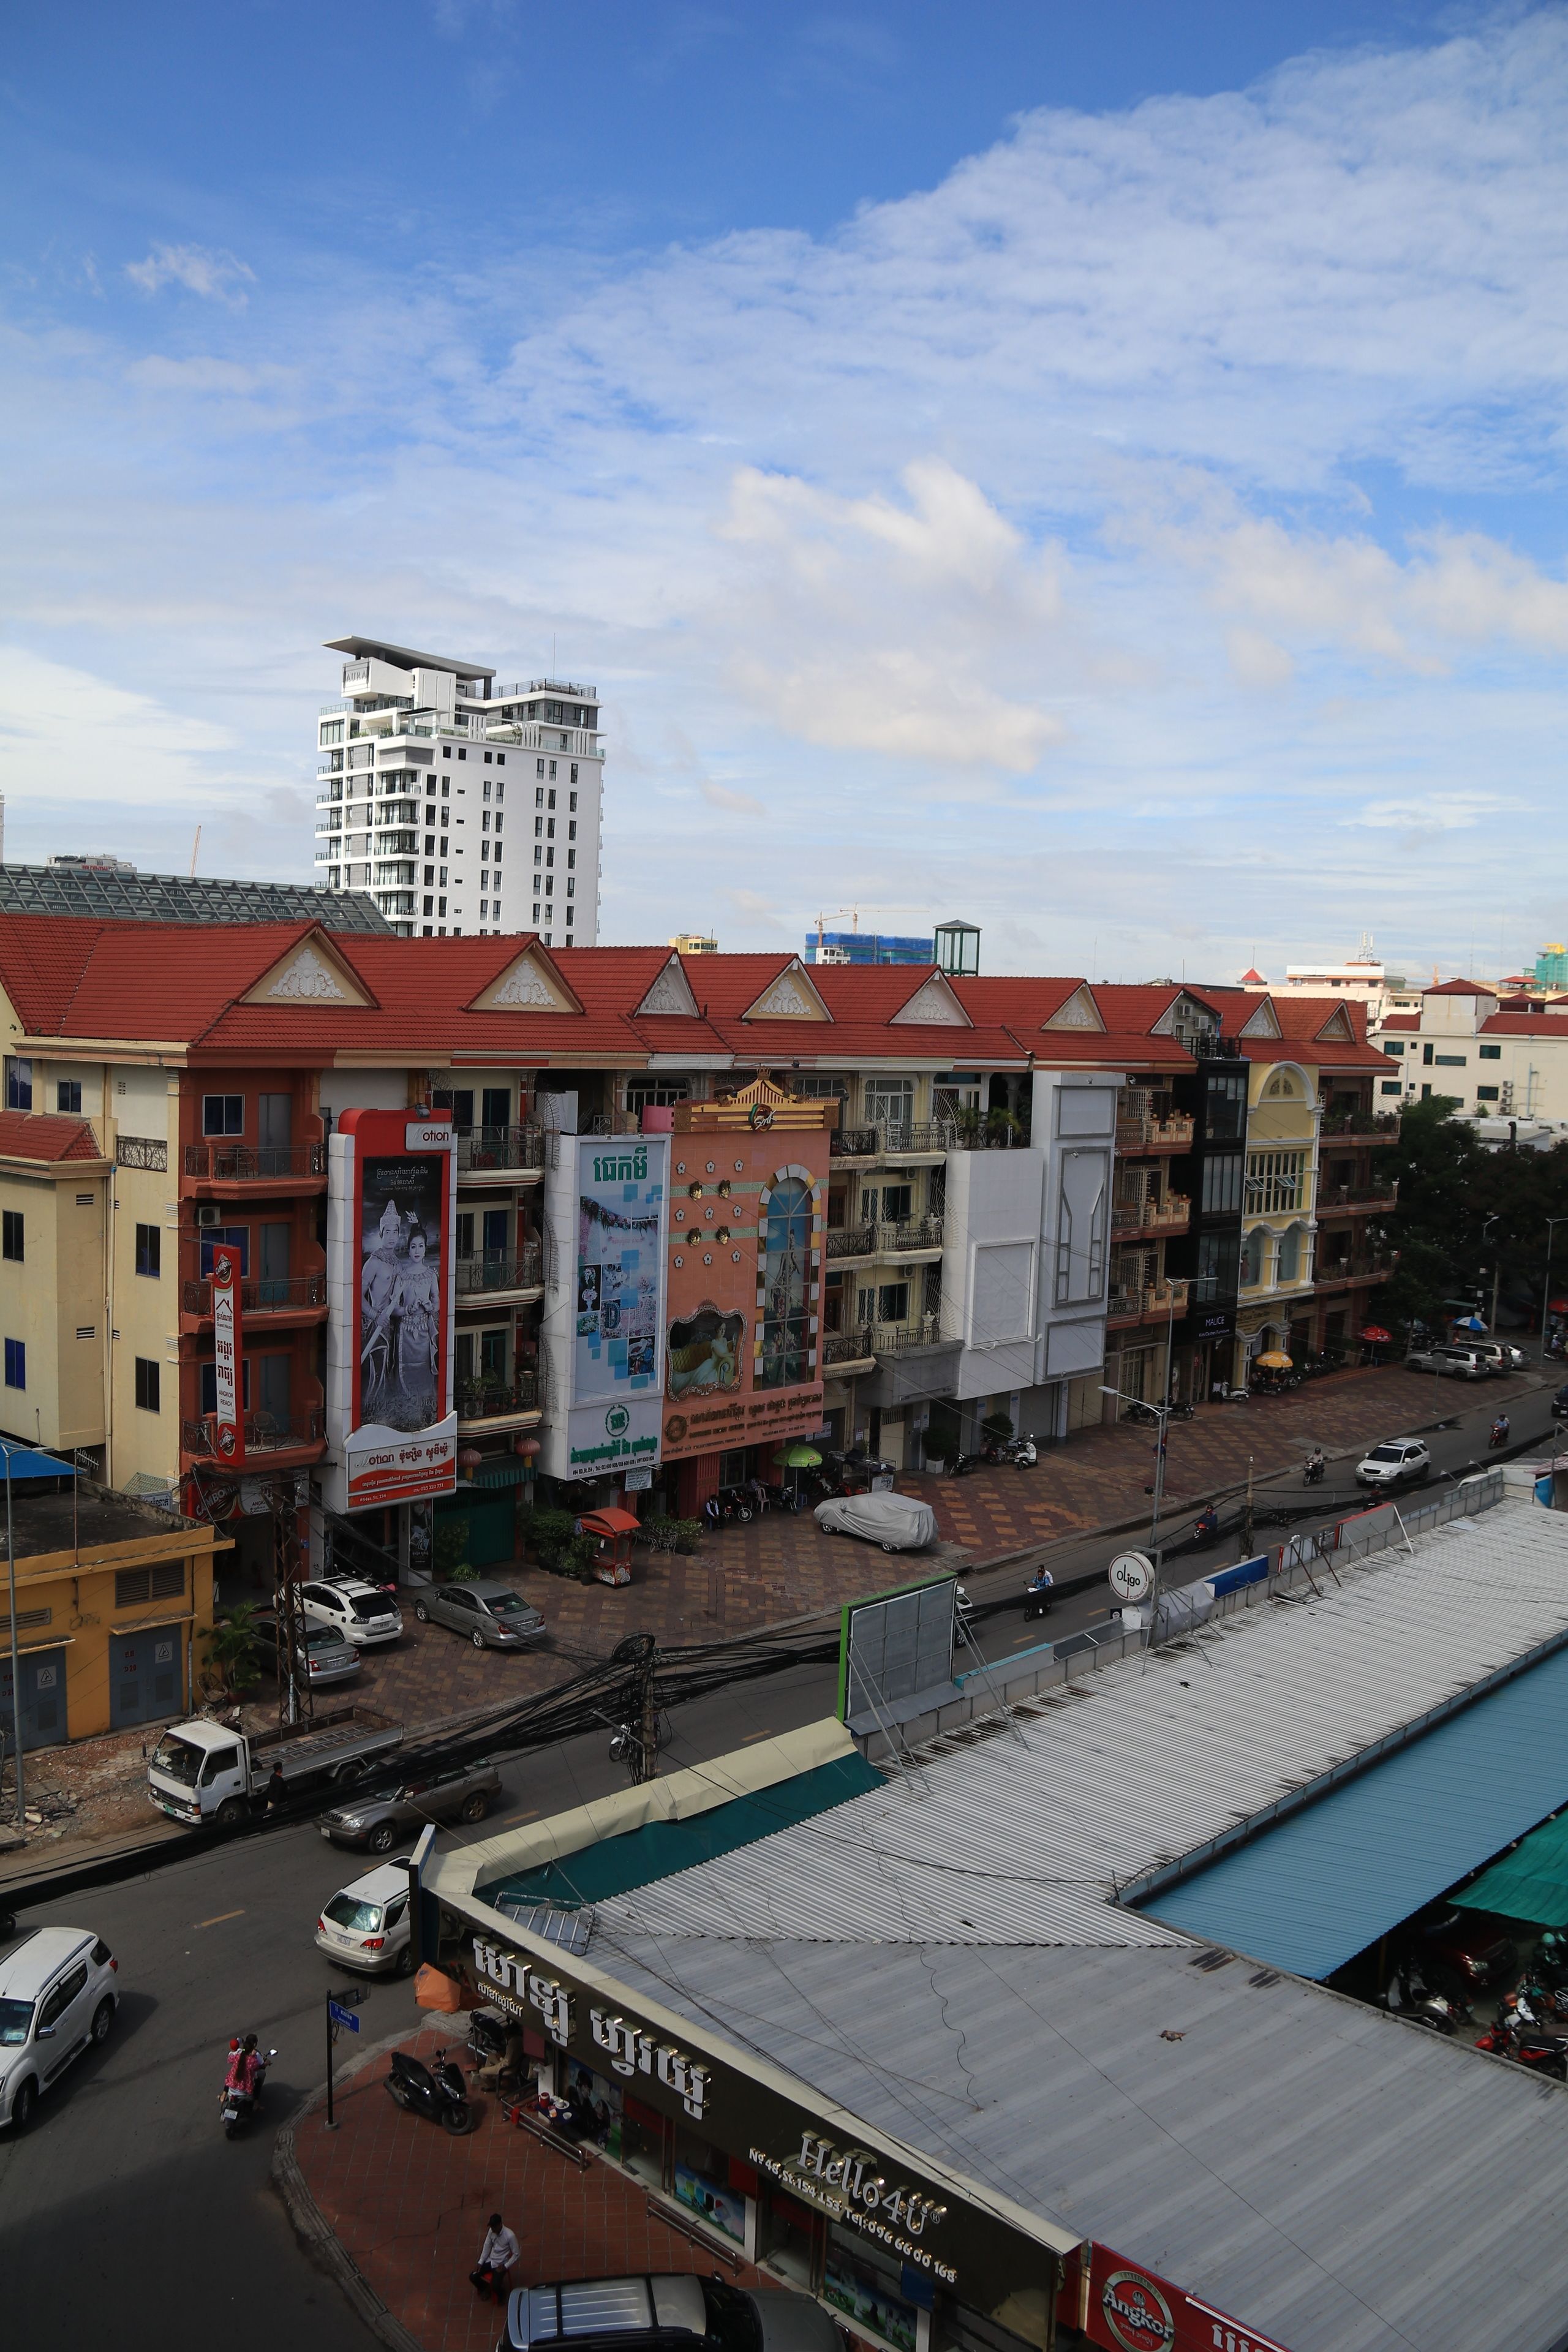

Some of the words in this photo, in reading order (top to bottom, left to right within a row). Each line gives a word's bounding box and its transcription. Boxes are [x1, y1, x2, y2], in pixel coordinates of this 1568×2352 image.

[219, 1389, 233, 1398] ANGKOR
[220, 1398, 232, 1407] REACH
[1102, 2288, 1175, 2342] Angkor
